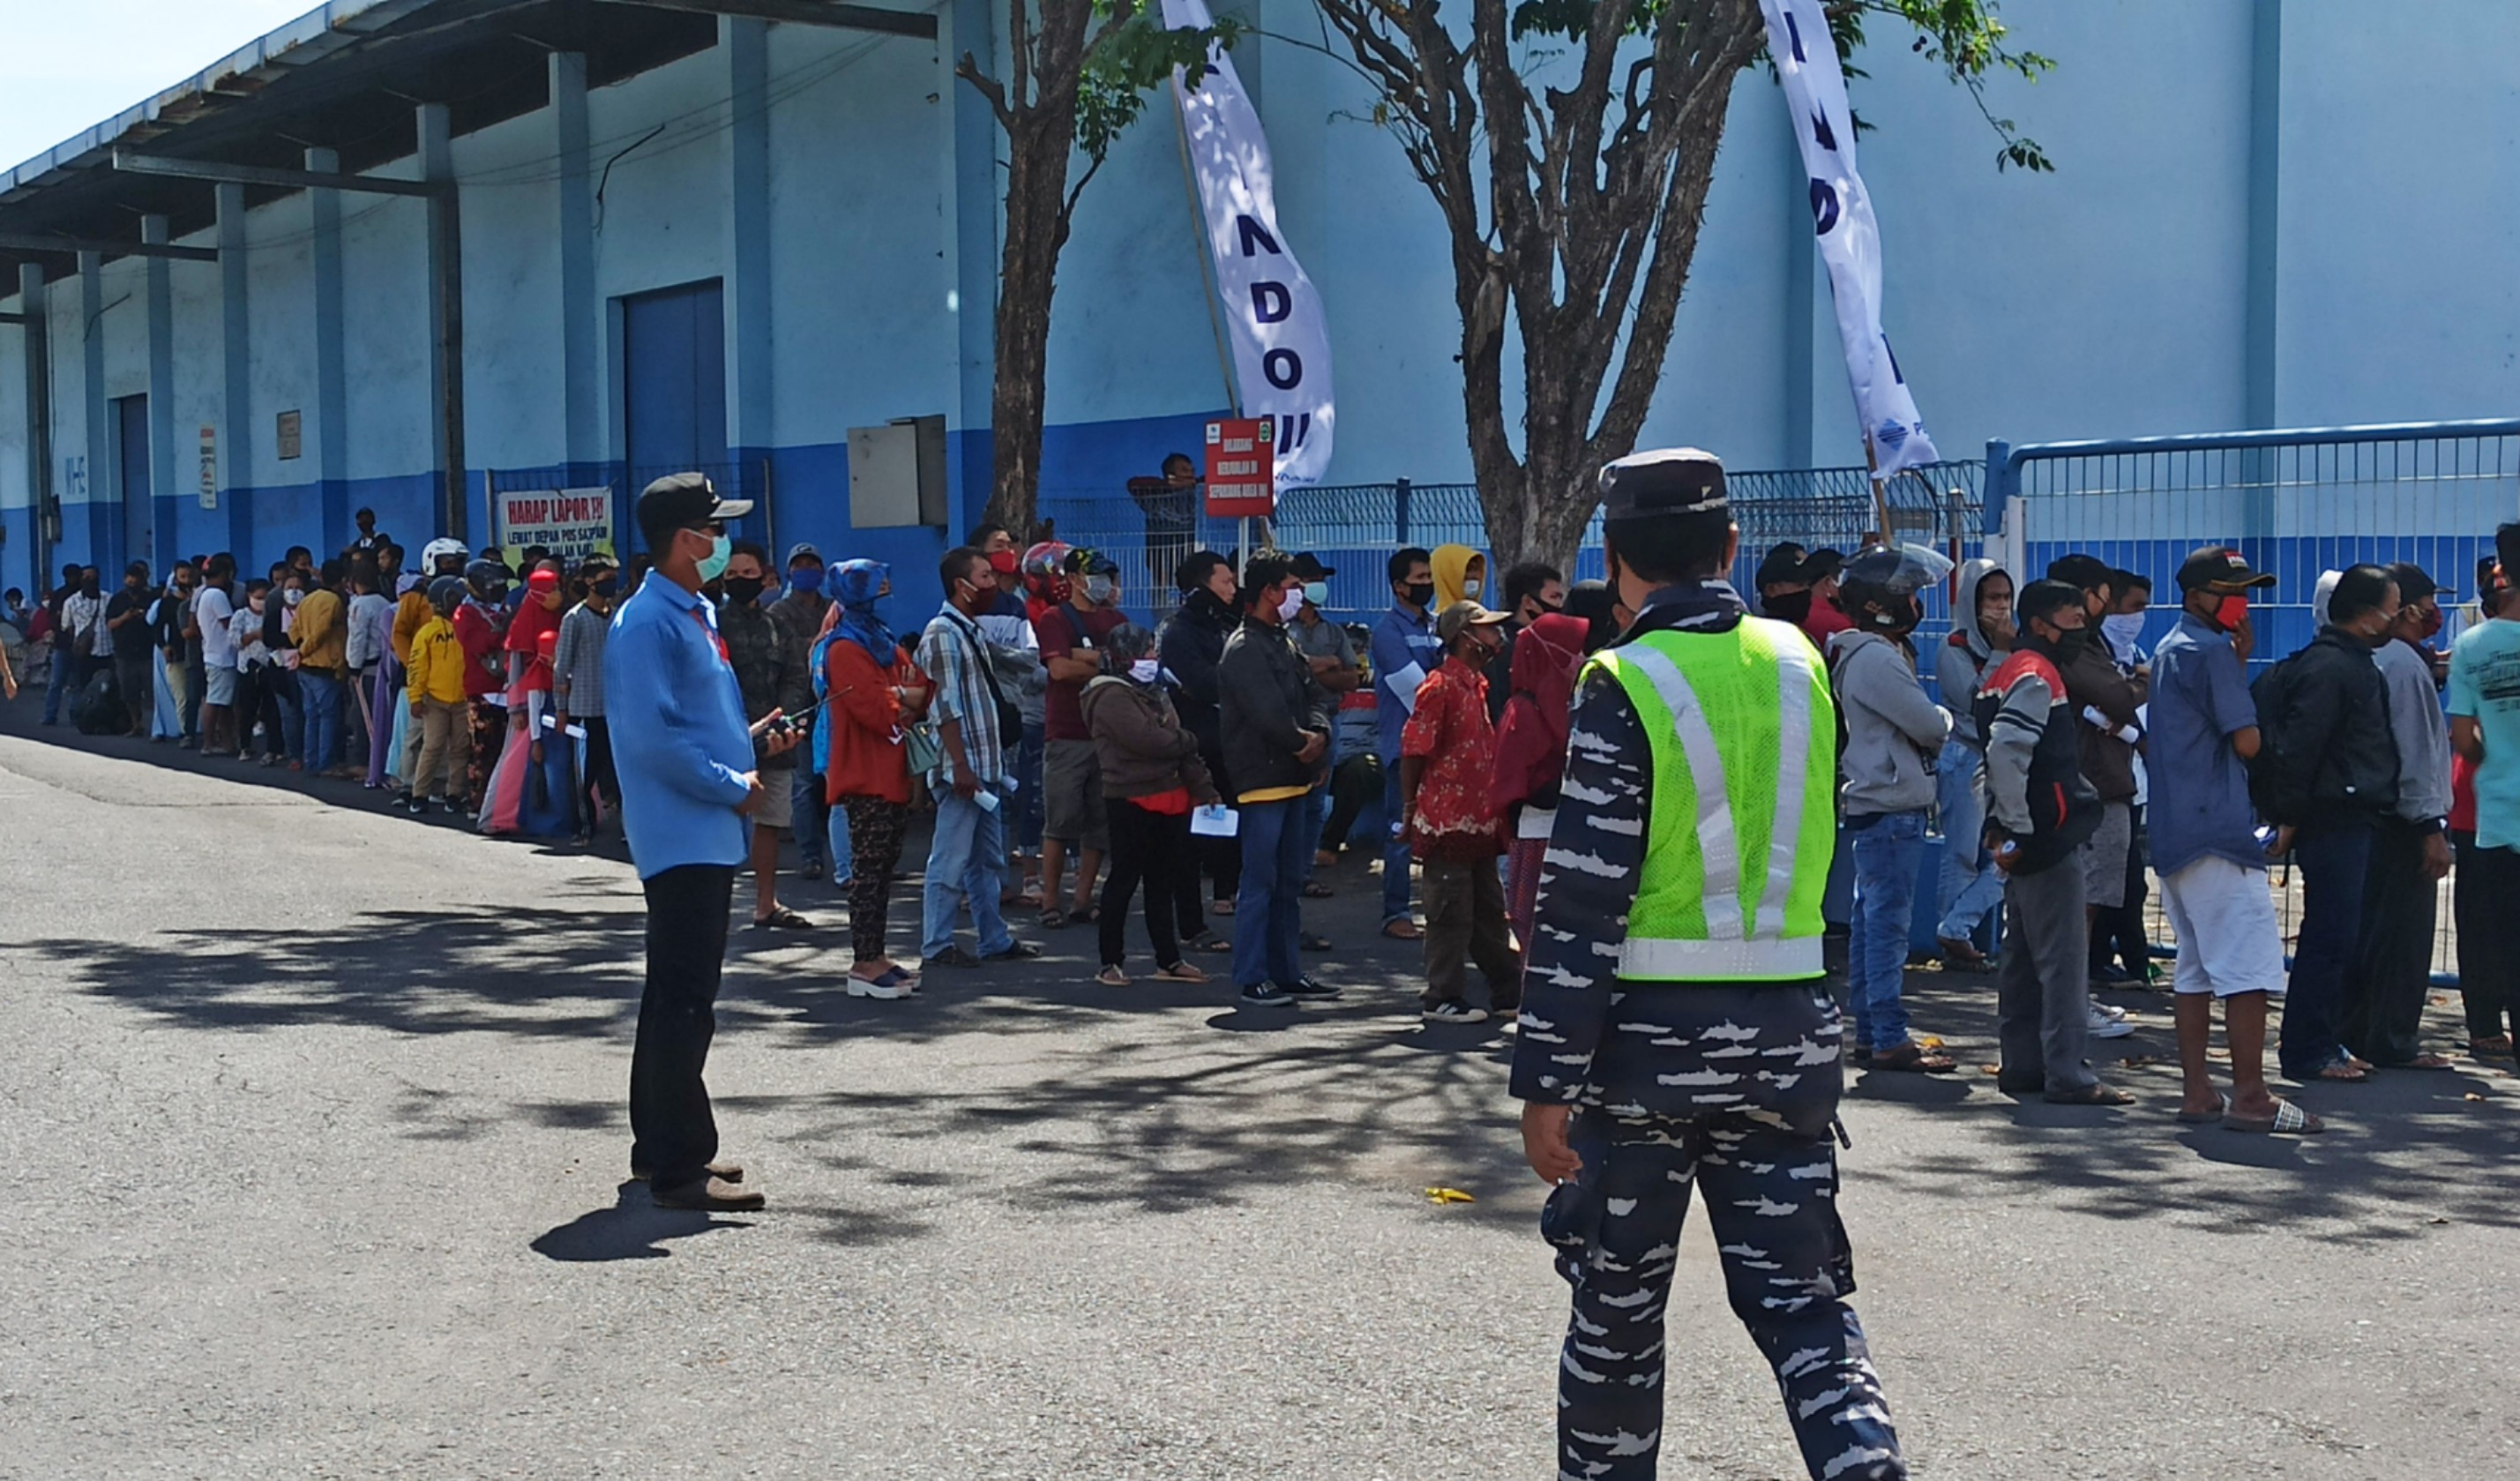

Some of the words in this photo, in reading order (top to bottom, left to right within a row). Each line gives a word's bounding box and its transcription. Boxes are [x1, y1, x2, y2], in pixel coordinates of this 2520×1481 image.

[508, 499, 549, 525] HARAP
[550, 497, 590, 523] LAPOR
[508, 531, 532, 545] LEWAT
[535, 529, 559, 543] DEPAN
[562, 527, 577, 542] POS
